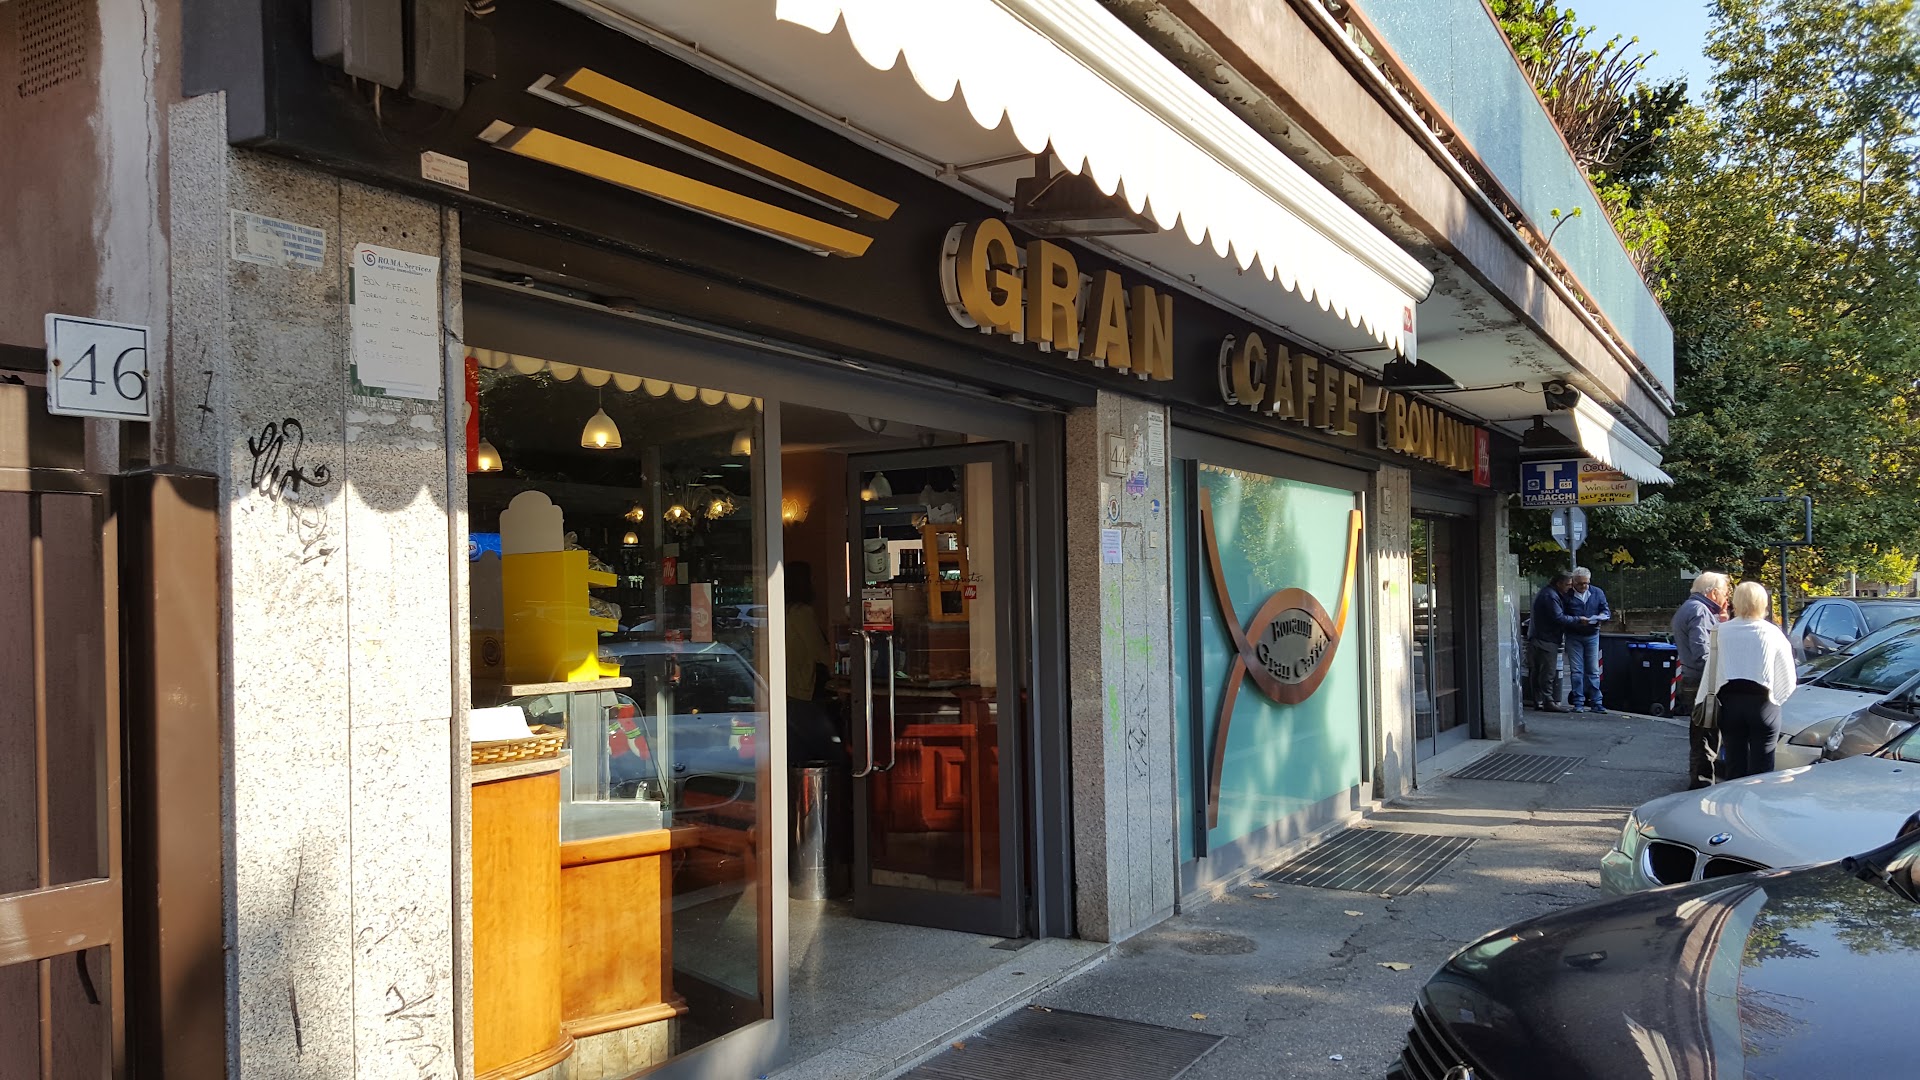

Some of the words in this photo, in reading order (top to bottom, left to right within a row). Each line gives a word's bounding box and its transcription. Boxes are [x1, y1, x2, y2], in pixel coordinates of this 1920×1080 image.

[405, 261, 432, 273] Services
[957, 217, 1173, 381] GRAN
[60, 343, 148, 401] 46
[1110, 445, 1126, 468] 44
[1536, 463, 1562, 490] T
[1583, 463, 1614, 473] LOT
[1525, 492, 1576, 502] TABACCHI
[663, 562, 676, 581] illy
[964, 587, 977, 598] illy
[1256, 643, 1291, 681] Gran
